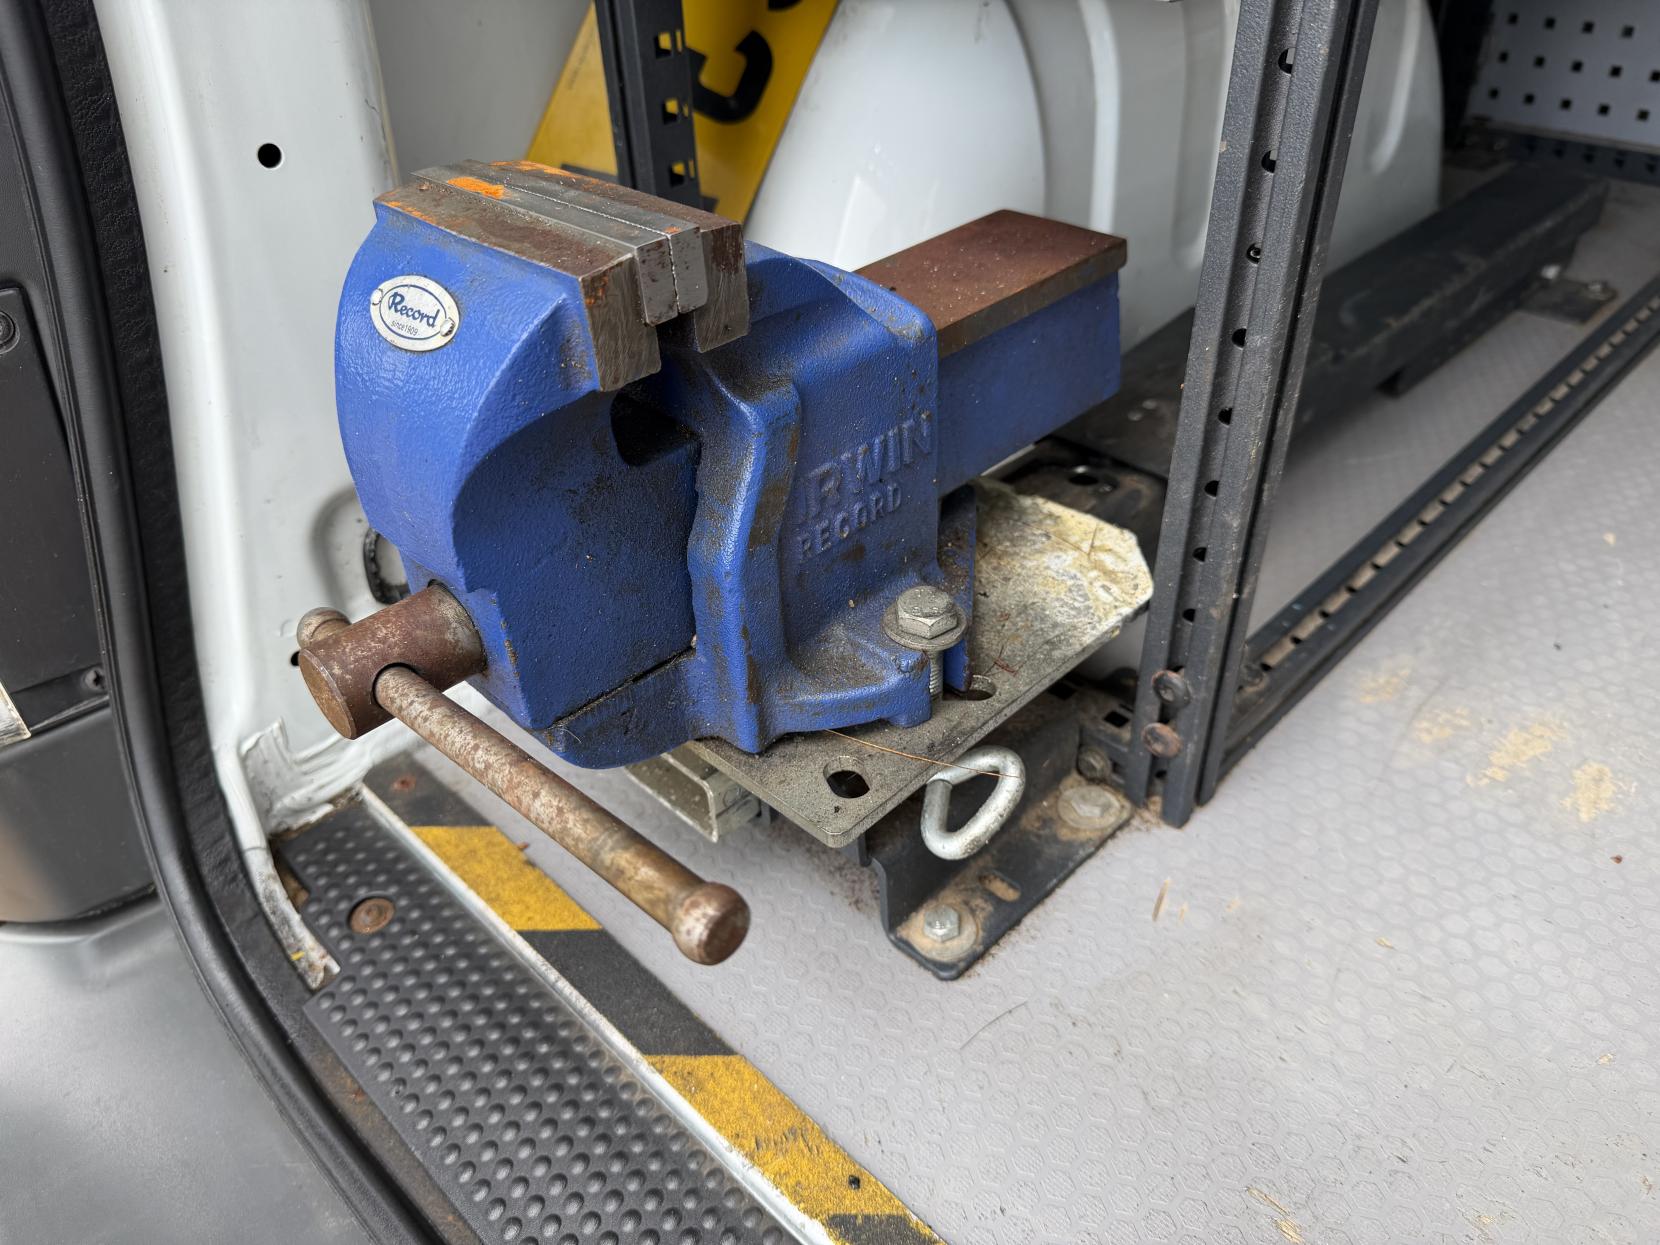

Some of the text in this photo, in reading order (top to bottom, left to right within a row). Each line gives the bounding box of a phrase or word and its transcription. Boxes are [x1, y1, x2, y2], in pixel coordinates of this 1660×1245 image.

[388, 291, 440, 328] Record
[796, 411, 932, 523] IRWIN
[798, 483, 901, 562] RECORD
